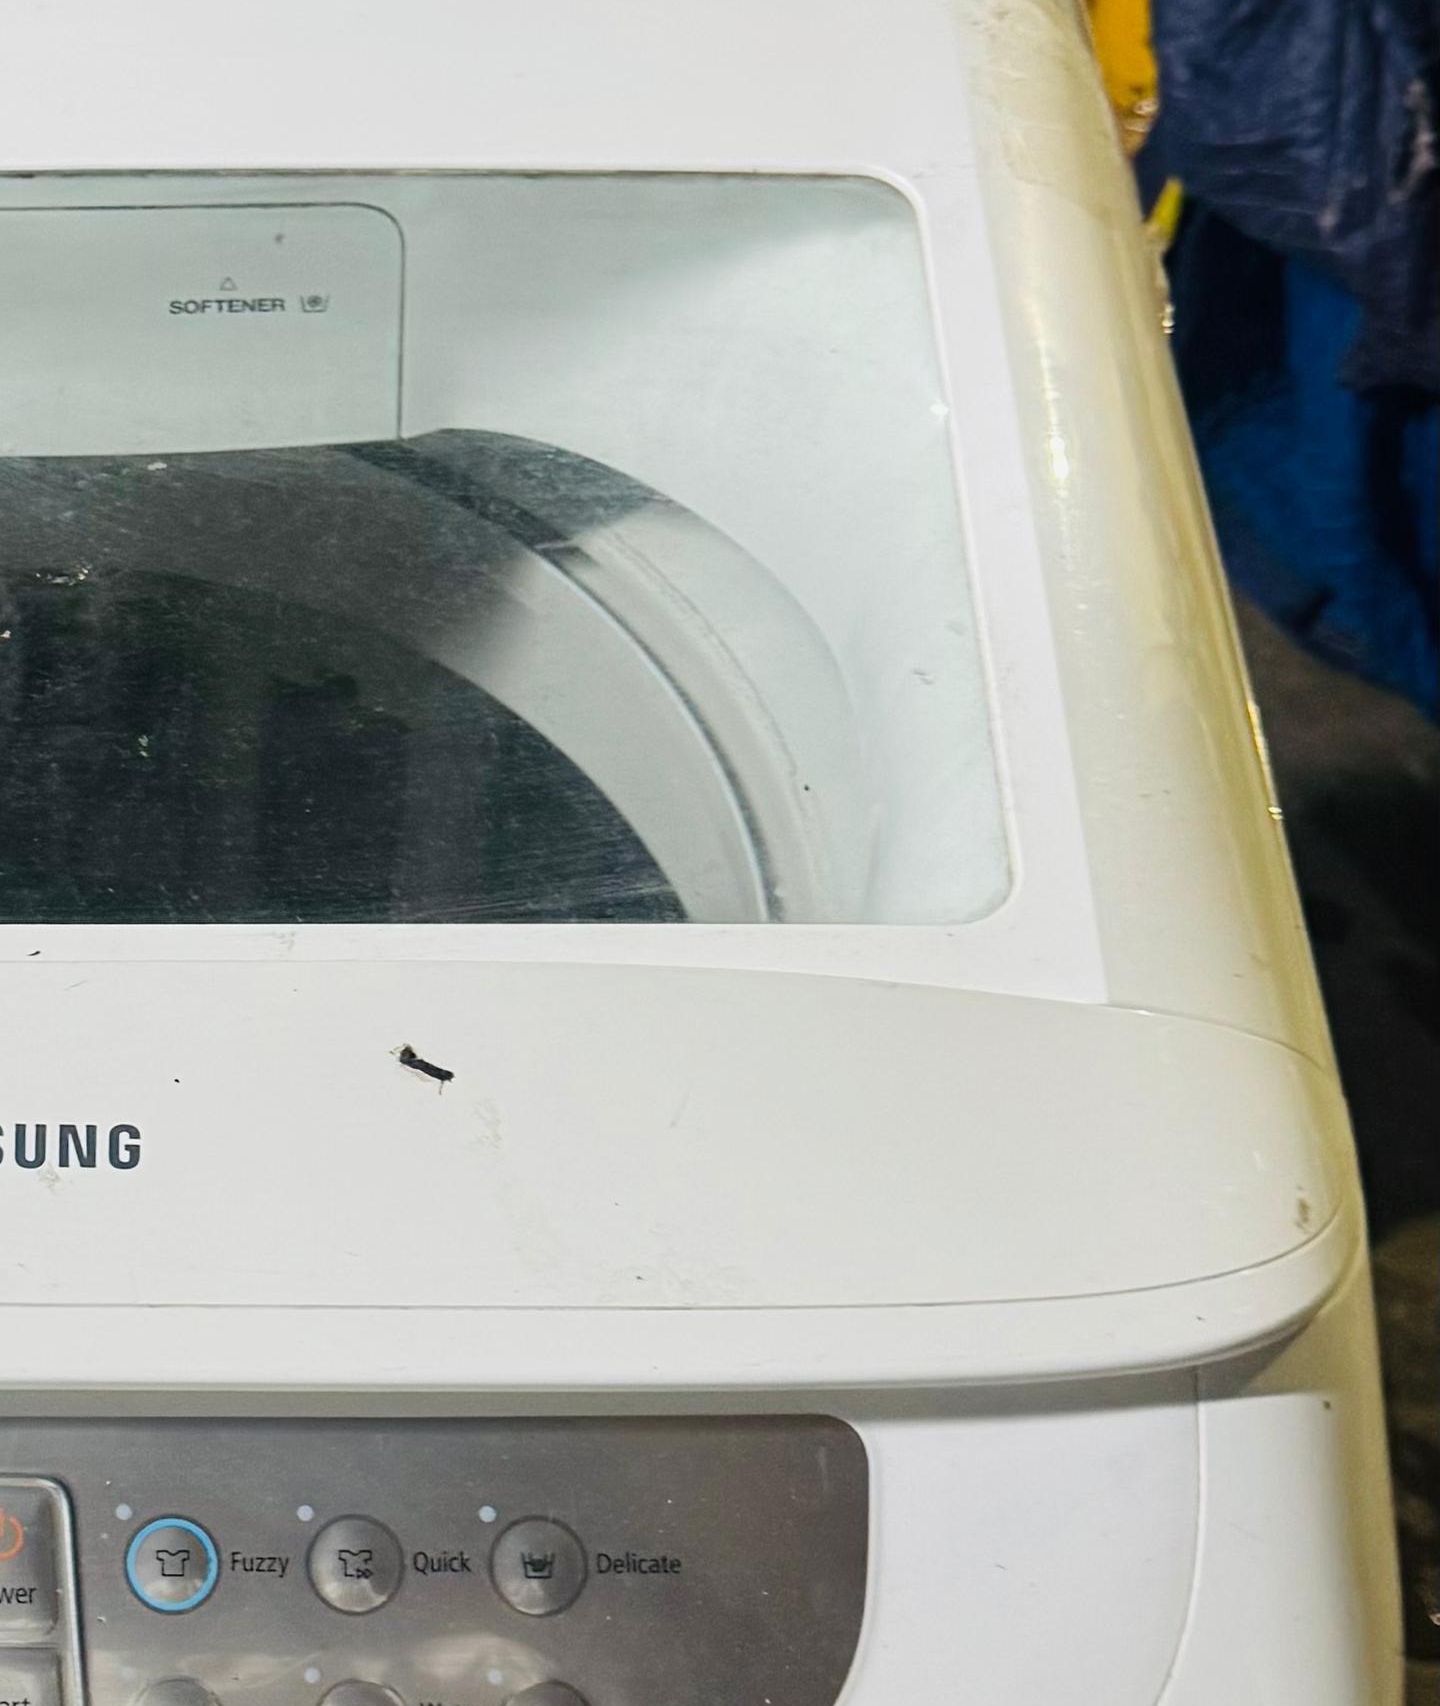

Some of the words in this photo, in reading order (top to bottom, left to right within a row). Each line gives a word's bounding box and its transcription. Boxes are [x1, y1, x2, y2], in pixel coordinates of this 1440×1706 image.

[168, 297, 286, 315] SOFTENER
[230, 1551, 289, 1578] Fuzzy
[412, 1551, 471, 1574] Quick
[596, 1552, 681, 1574] Delicate
